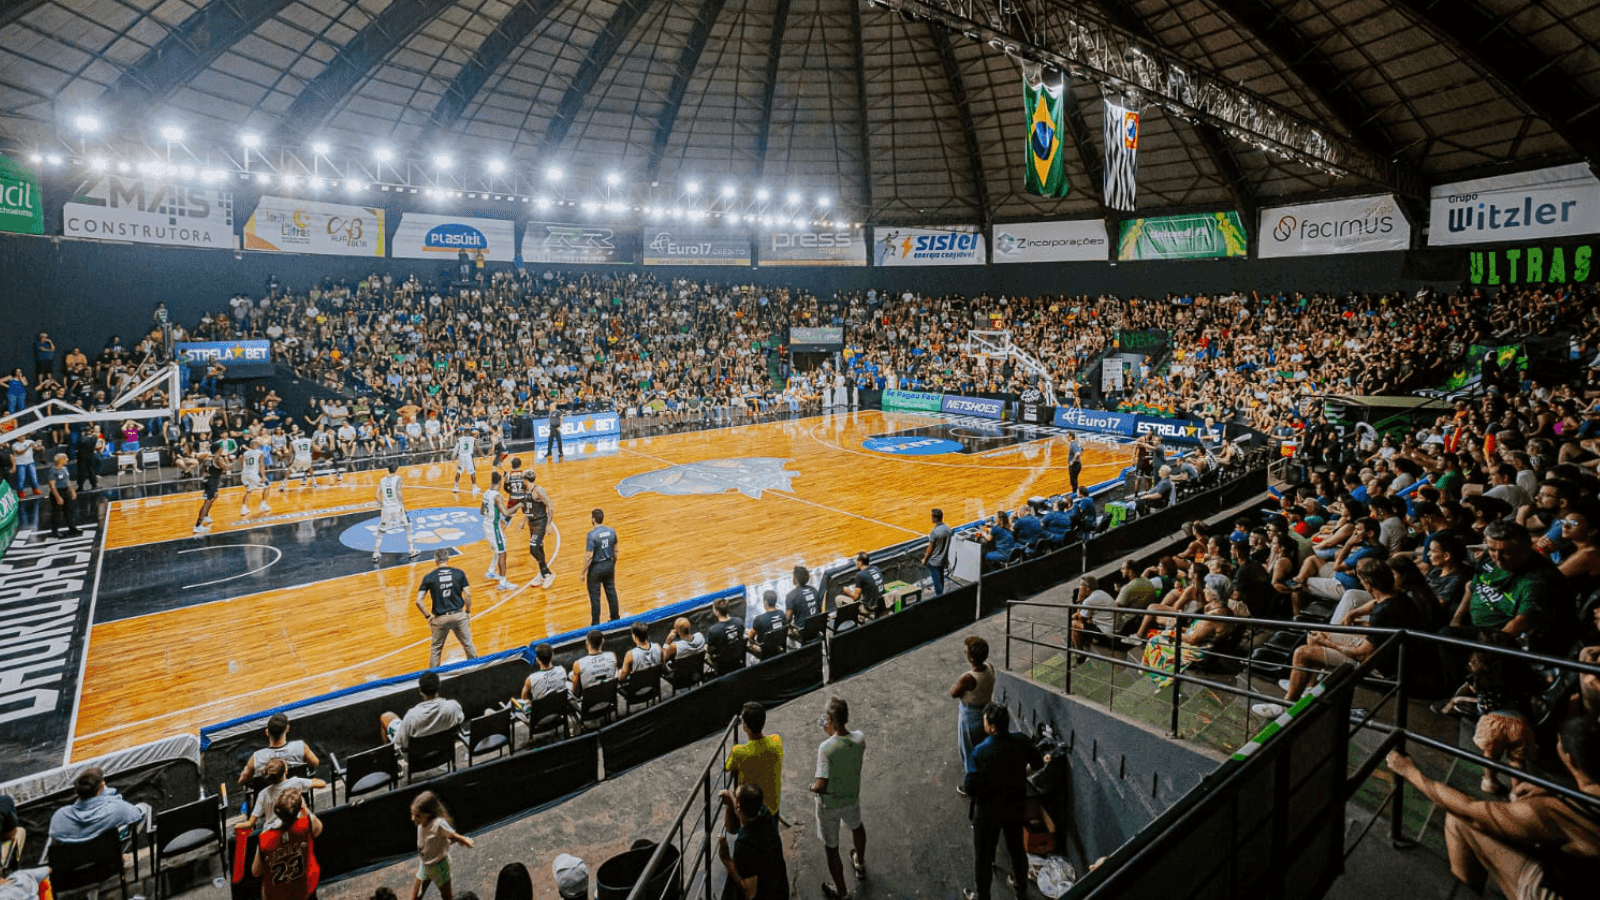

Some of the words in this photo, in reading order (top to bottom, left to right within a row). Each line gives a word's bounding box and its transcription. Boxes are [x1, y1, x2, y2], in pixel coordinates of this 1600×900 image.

[1448, 193, 1478, 204] Grupo
[67, 217, 212, 242] CONSTRUTORA
[1300, 216, 1394, 240] facimus
[771, 232, 850, 251] press
[1016, 238, 1026, 249] Z
[667, 243, 711, 255] Euro17
[1470, 245, 1592, 285] ULTRAS
[245, 348, 267, 359] BET
[947, 400, 998, 414] NETSHOES
[596, 418, 617, 432] BET
[1077, 414, 1121, 429] Euro17
[1137, 421, 1185, 437] ESTRELA
